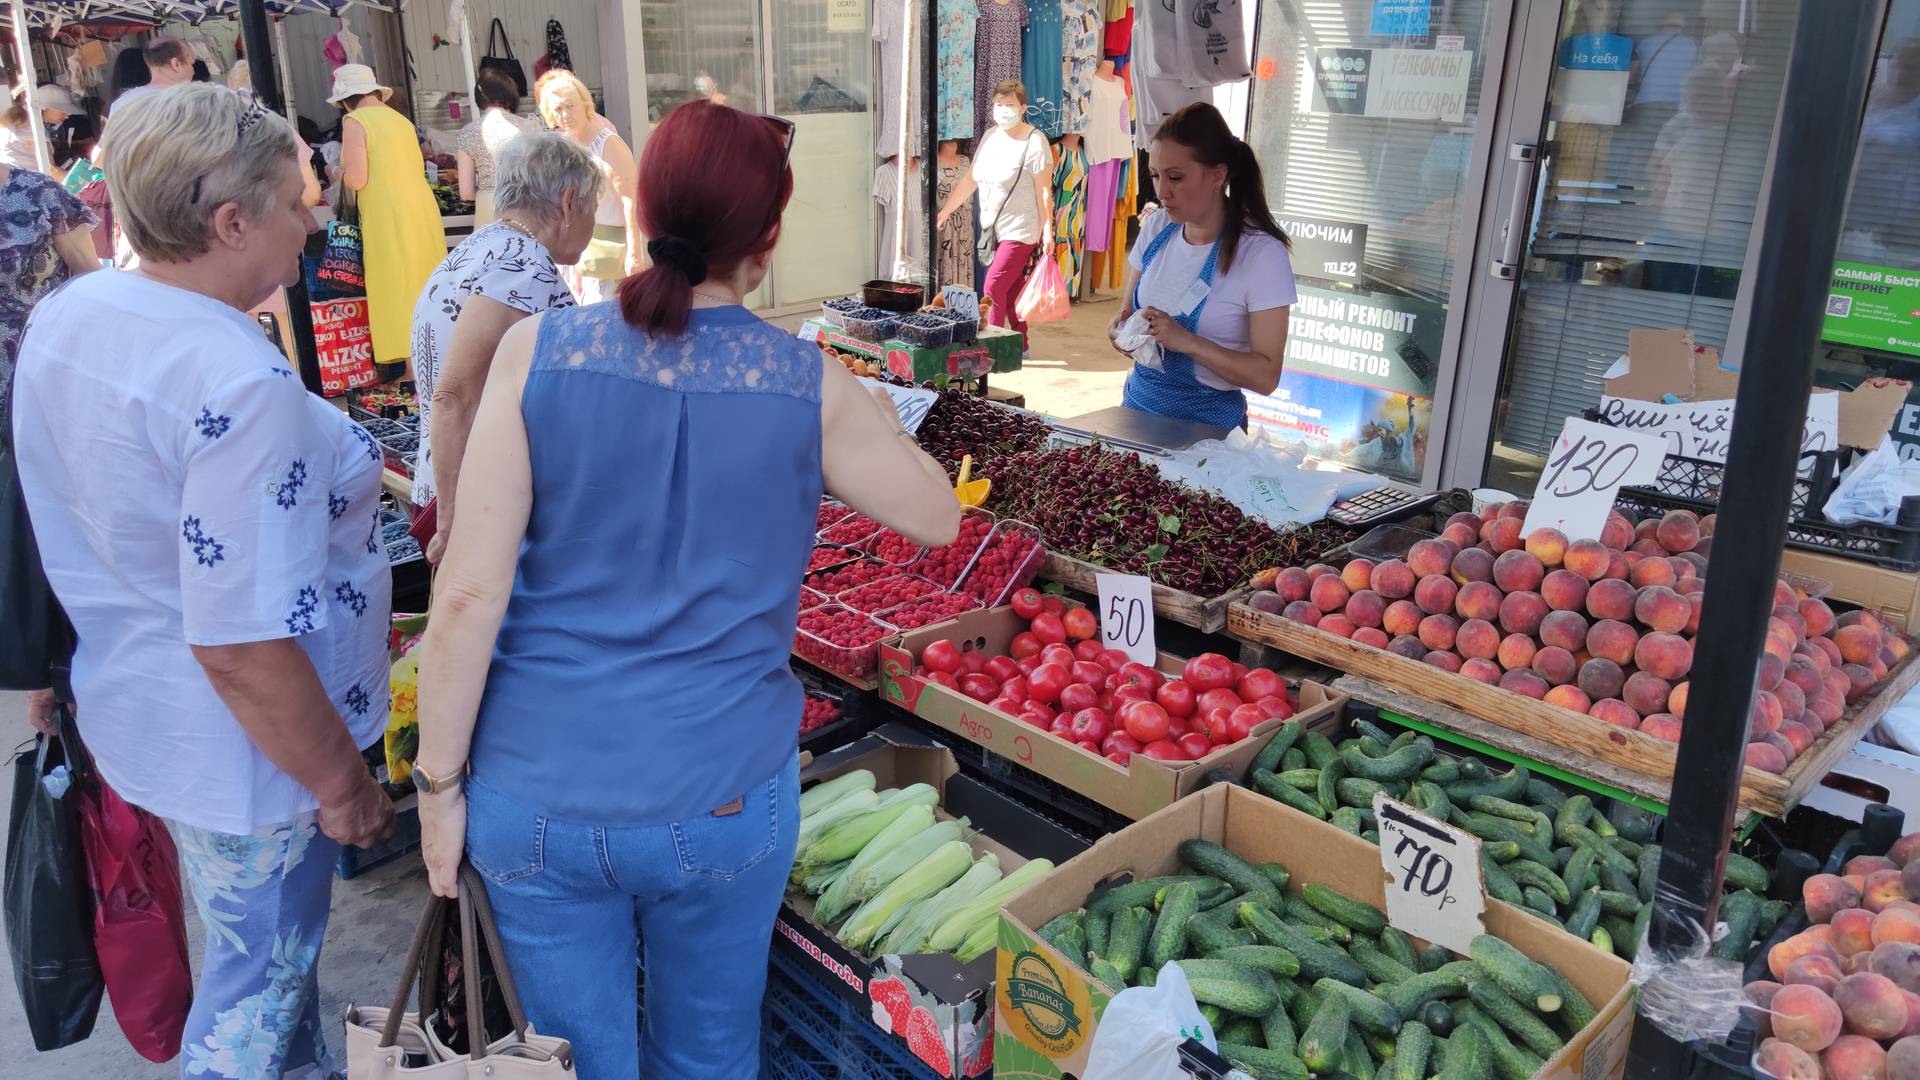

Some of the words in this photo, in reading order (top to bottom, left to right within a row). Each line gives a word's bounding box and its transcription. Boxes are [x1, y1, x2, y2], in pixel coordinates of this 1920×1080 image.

[1573, 52, 1588, 64] На
[1592, 52, 1618, 64] себя
[1324, 261, 1357, 277] TELE2
[1834, 267, 1882, 282] САМЫЙ
[945, 291, 973, 309] 1000
[1832, 279, 1892, 295] ИНТЕРНЕТ
[1290, 294, 1345, 321] ЧНЫЙ
[1347, 303, 1417, 334] РЕМОНТ
[1289, 315, 1385, 352] ТЕЛЕФОНОВ
[1290, 339, 1391, 378] ПЛАНШЕТОВ
[1544, 435, 1639, 498] 130
[1107, 594, 1145, 647] 50
[960, 712, 993, 740] Agro
[1394, 837, 1453, 896] 70
[821, 953, 864, 994] ягода
[1021, 967, 1054, 987] Premium
[1018, 983, 1064, 1012] Bananas
[1024, 1023, 1048, 1049] Quality
